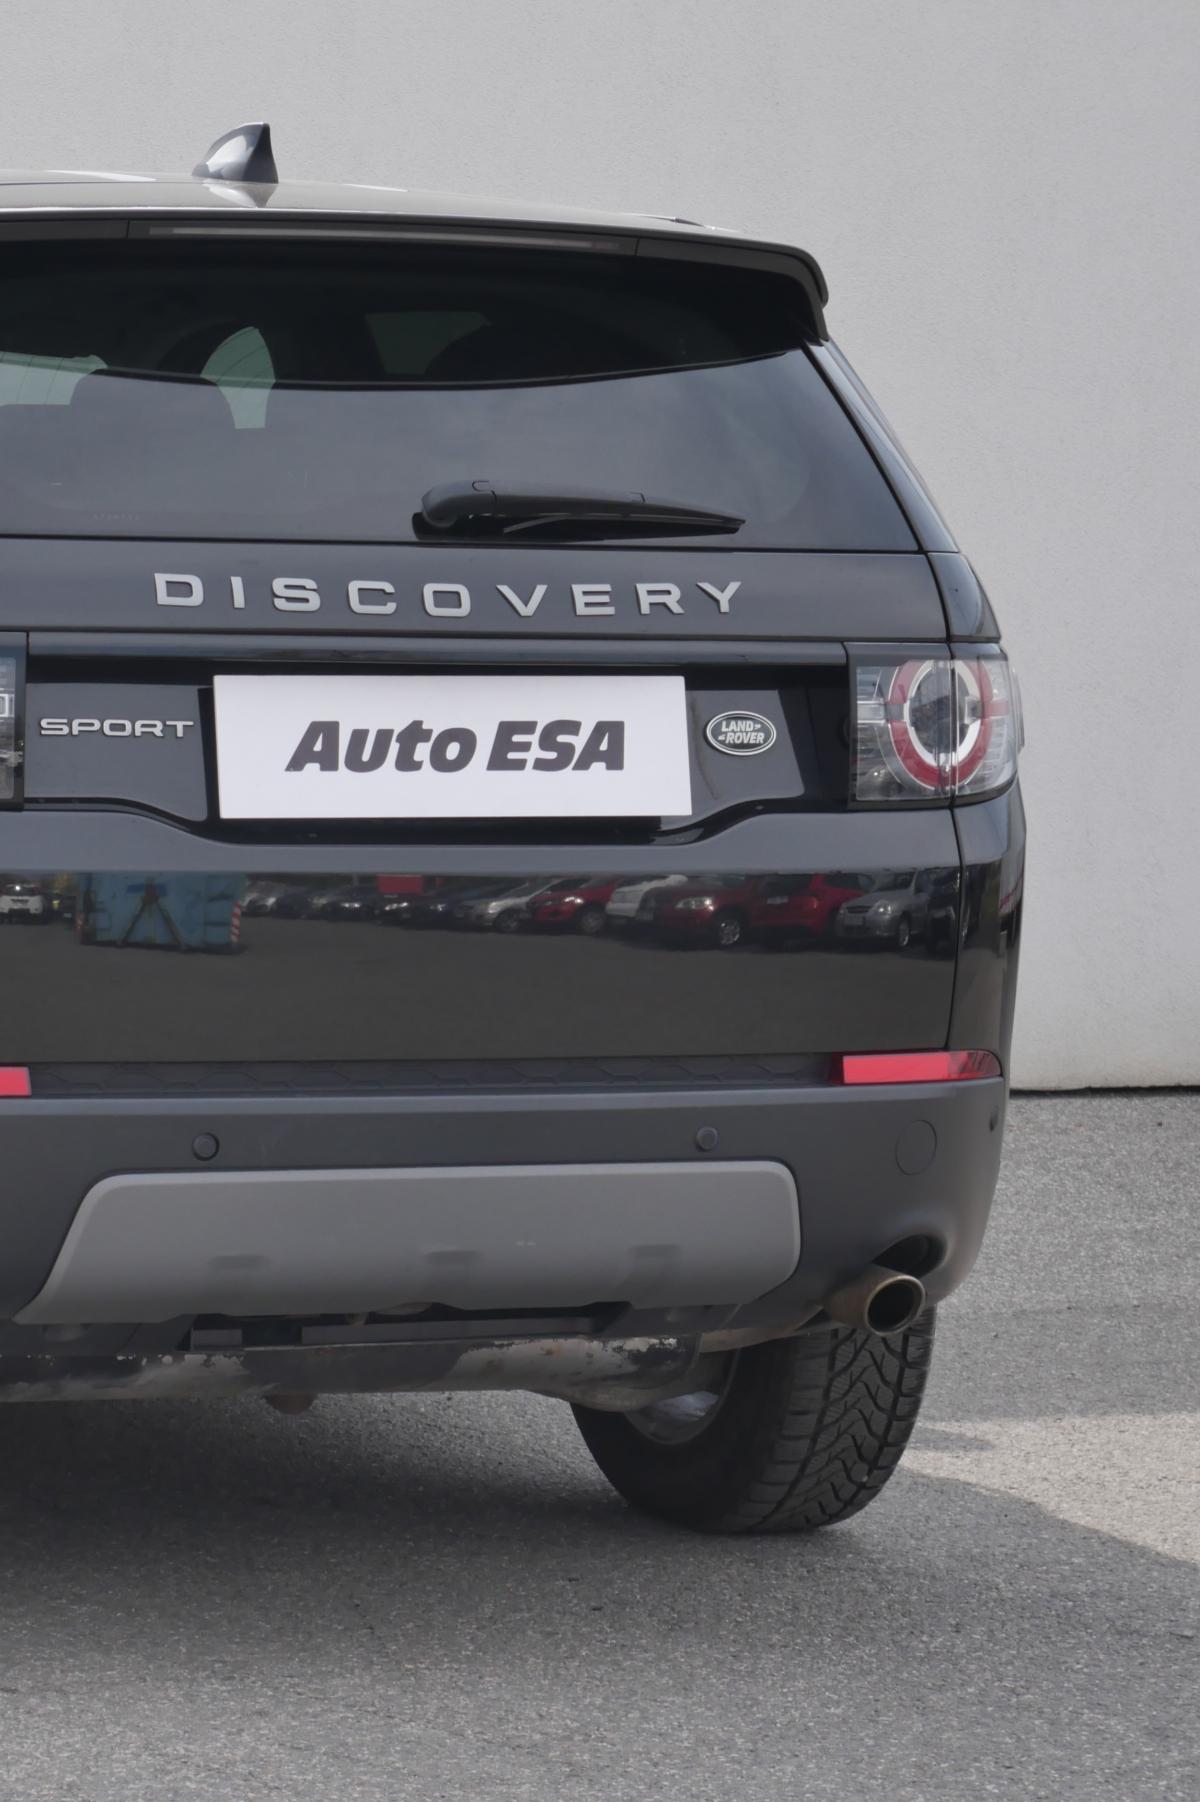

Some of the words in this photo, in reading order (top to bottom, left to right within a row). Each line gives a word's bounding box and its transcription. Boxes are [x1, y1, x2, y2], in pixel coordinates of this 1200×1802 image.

[153, 572, 743, 618] DISCOVERY
[39, 717, 195, 740] SPORT
[721, 720, 754, 732] LAND
[284, 719, 478, 773] Auto
[485, 719, 626, 772] ESA
[725, 732, 765, 744] ROVER
